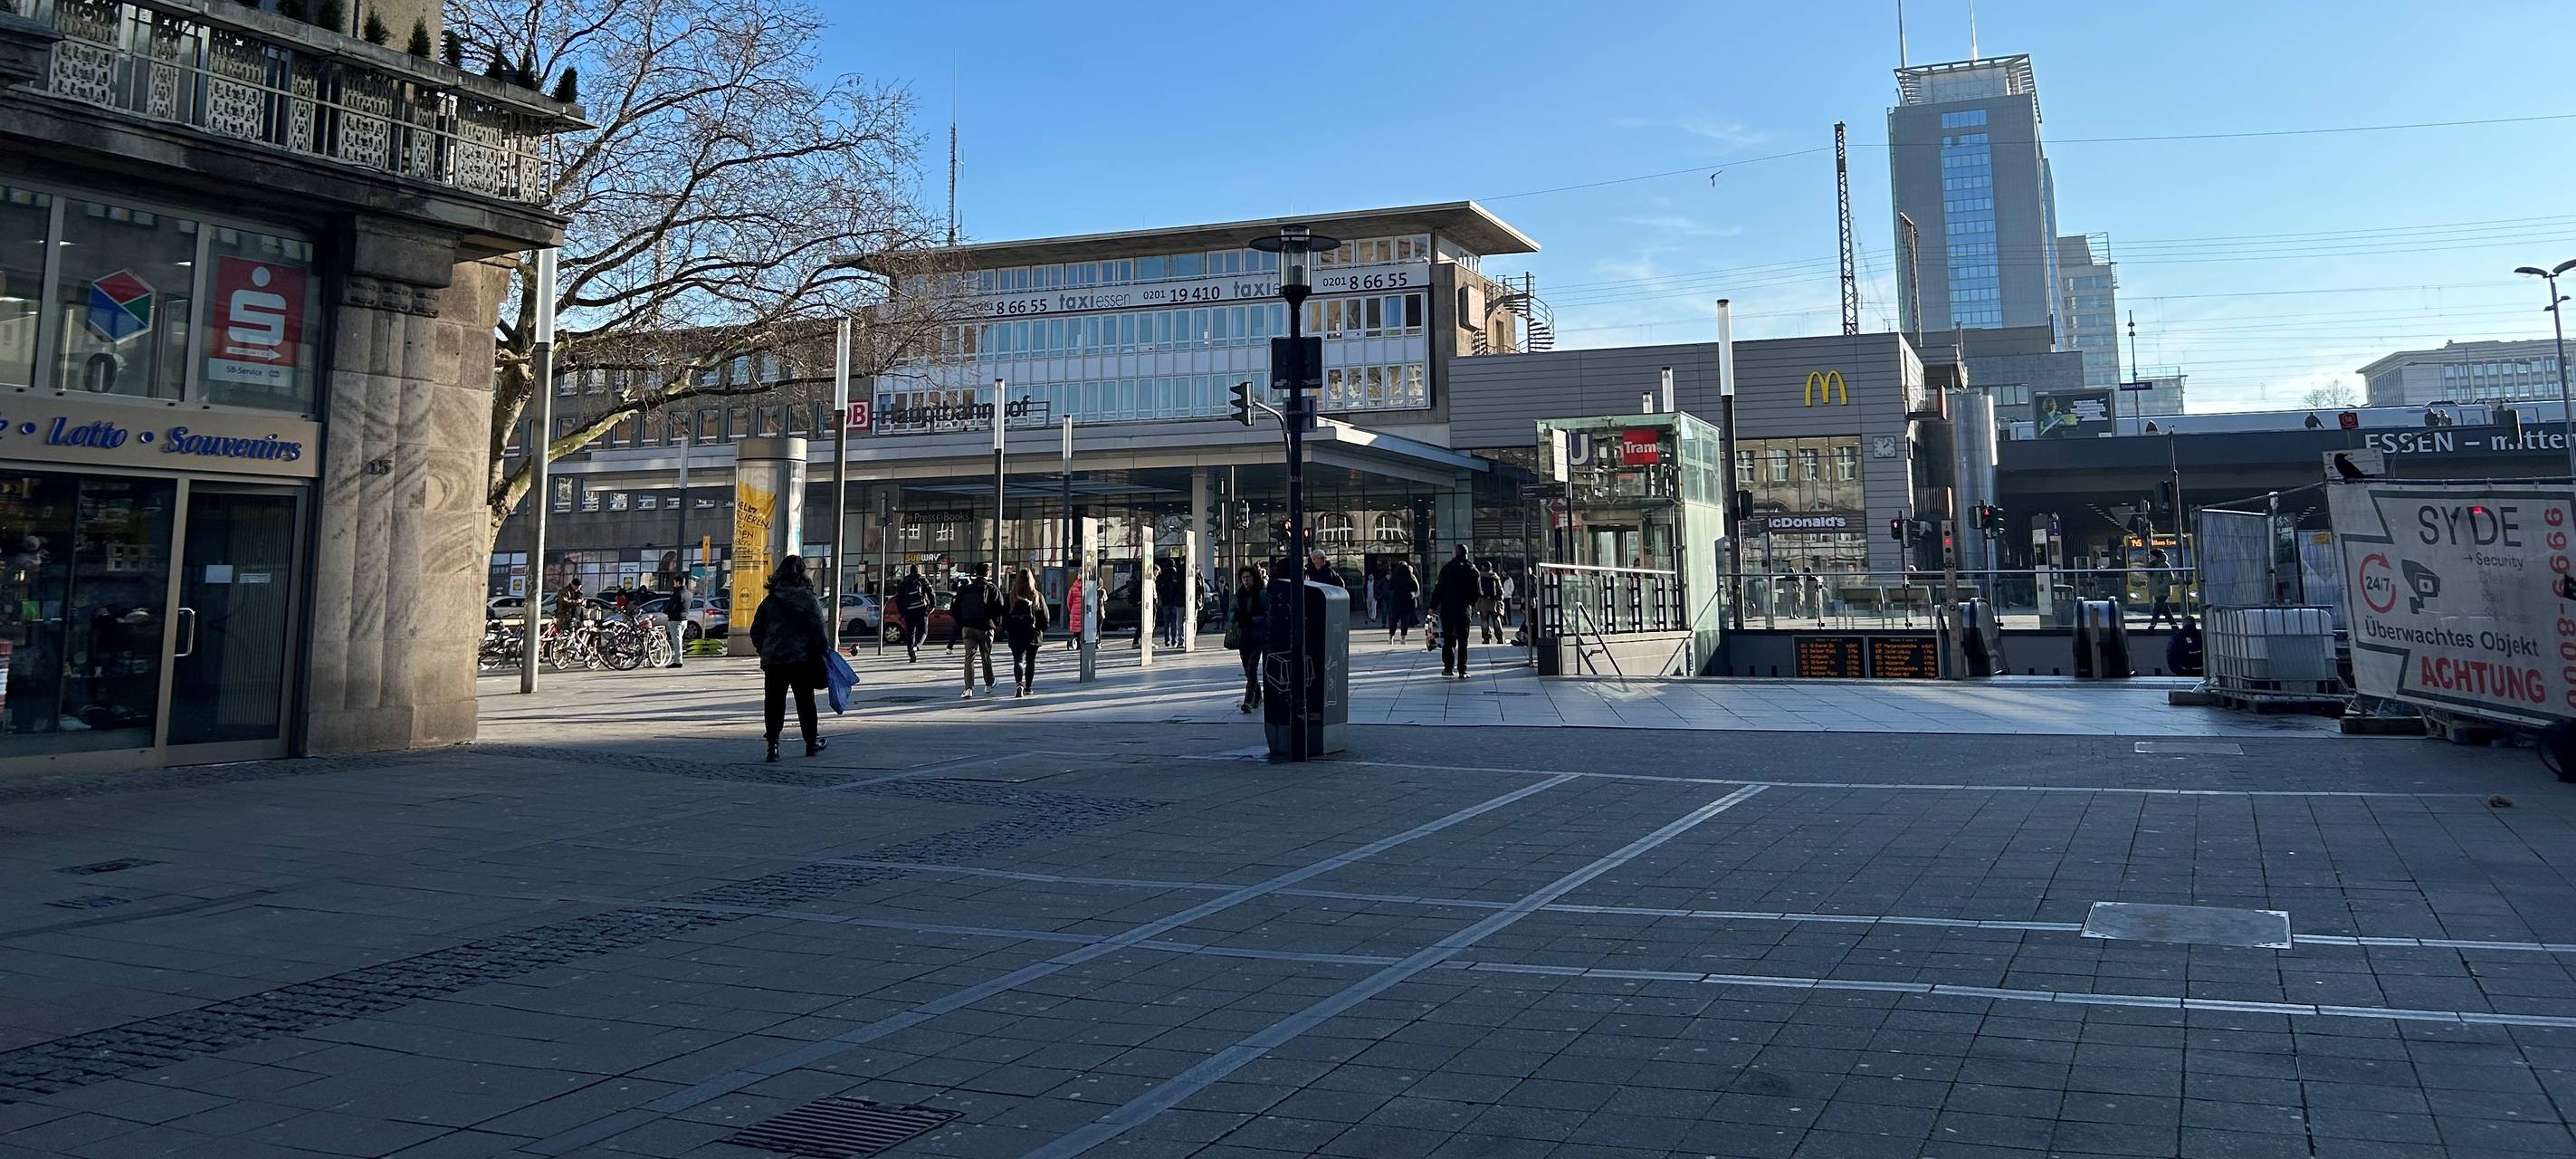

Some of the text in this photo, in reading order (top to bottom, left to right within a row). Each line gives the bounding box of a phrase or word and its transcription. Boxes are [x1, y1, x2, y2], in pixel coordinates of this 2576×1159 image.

[1009, 300, 1026, 313] 66
[1031, 299, 1047, 311] 55
[1143, 290, 1166, 301] 0201
[1170, 289, 1188, 302] 19
[1192, 286, 1220, 300] 410
[1323, 277, 1347, 287] 0201
[1350, 275, 1359, 290] 8
[1363, 274, 1383, 288] 66
[1388, 273, 1407, 287] 55
[46, 417, 129, 448] Lotto
[160, 426, 302, 461] Souvenirs
[1569, 434, 1589, 465] U
[1623, 441, 1656, 453] Tram
[2365, 432, 2454, 453] ESSEN
[369, 458, 392, 475] 15
[2418, 505, 2523, 548] SYDE
[906, 552, 941, 561] SUBWAY
[2476, 552, 2524, 571] Security
[2365, 576, 2390, 592] 24/7
[2365, 616, 2541, 658] Überwachtes Objekt
[2421, 656, 2546, 704] ACHTUNG
